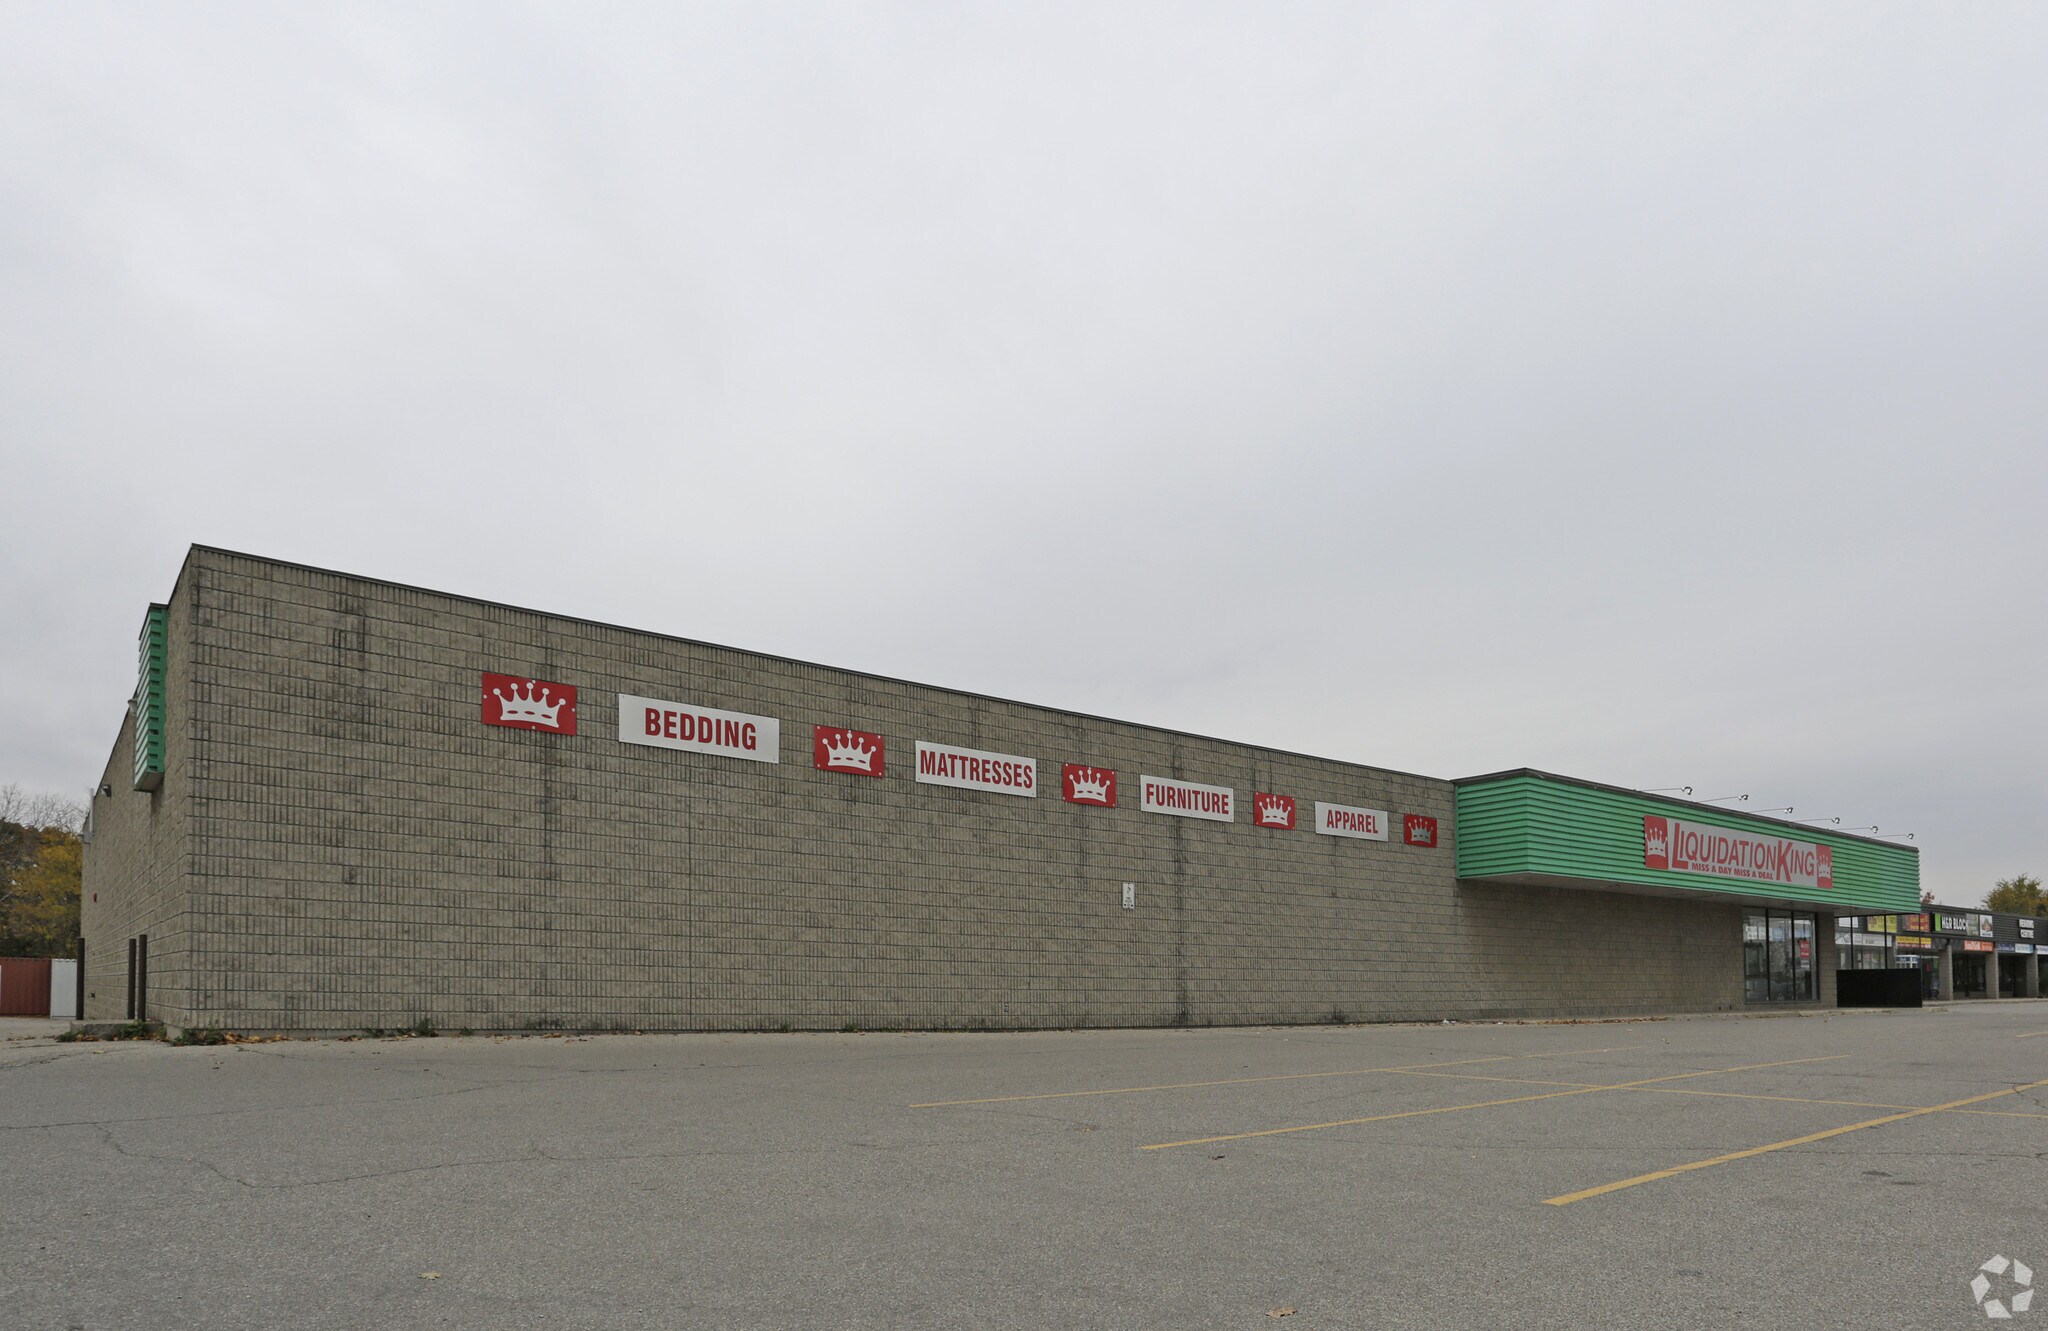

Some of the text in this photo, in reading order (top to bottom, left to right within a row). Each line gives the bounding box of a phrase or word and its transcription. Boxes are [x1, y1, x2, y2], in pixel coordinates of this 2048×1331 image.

[646, 708, 756, 750] BEDDING
[920, 750, 1033, 789] MATTRESSES
[1146, 783, 1229, 815] FURNITURE
[1327, 810, 1377, 834] APPAREL
[1692, 863, 1774, 880] MISS A DAY MISS A DEAL
[1953, 917, 1967, 931] BLOC
